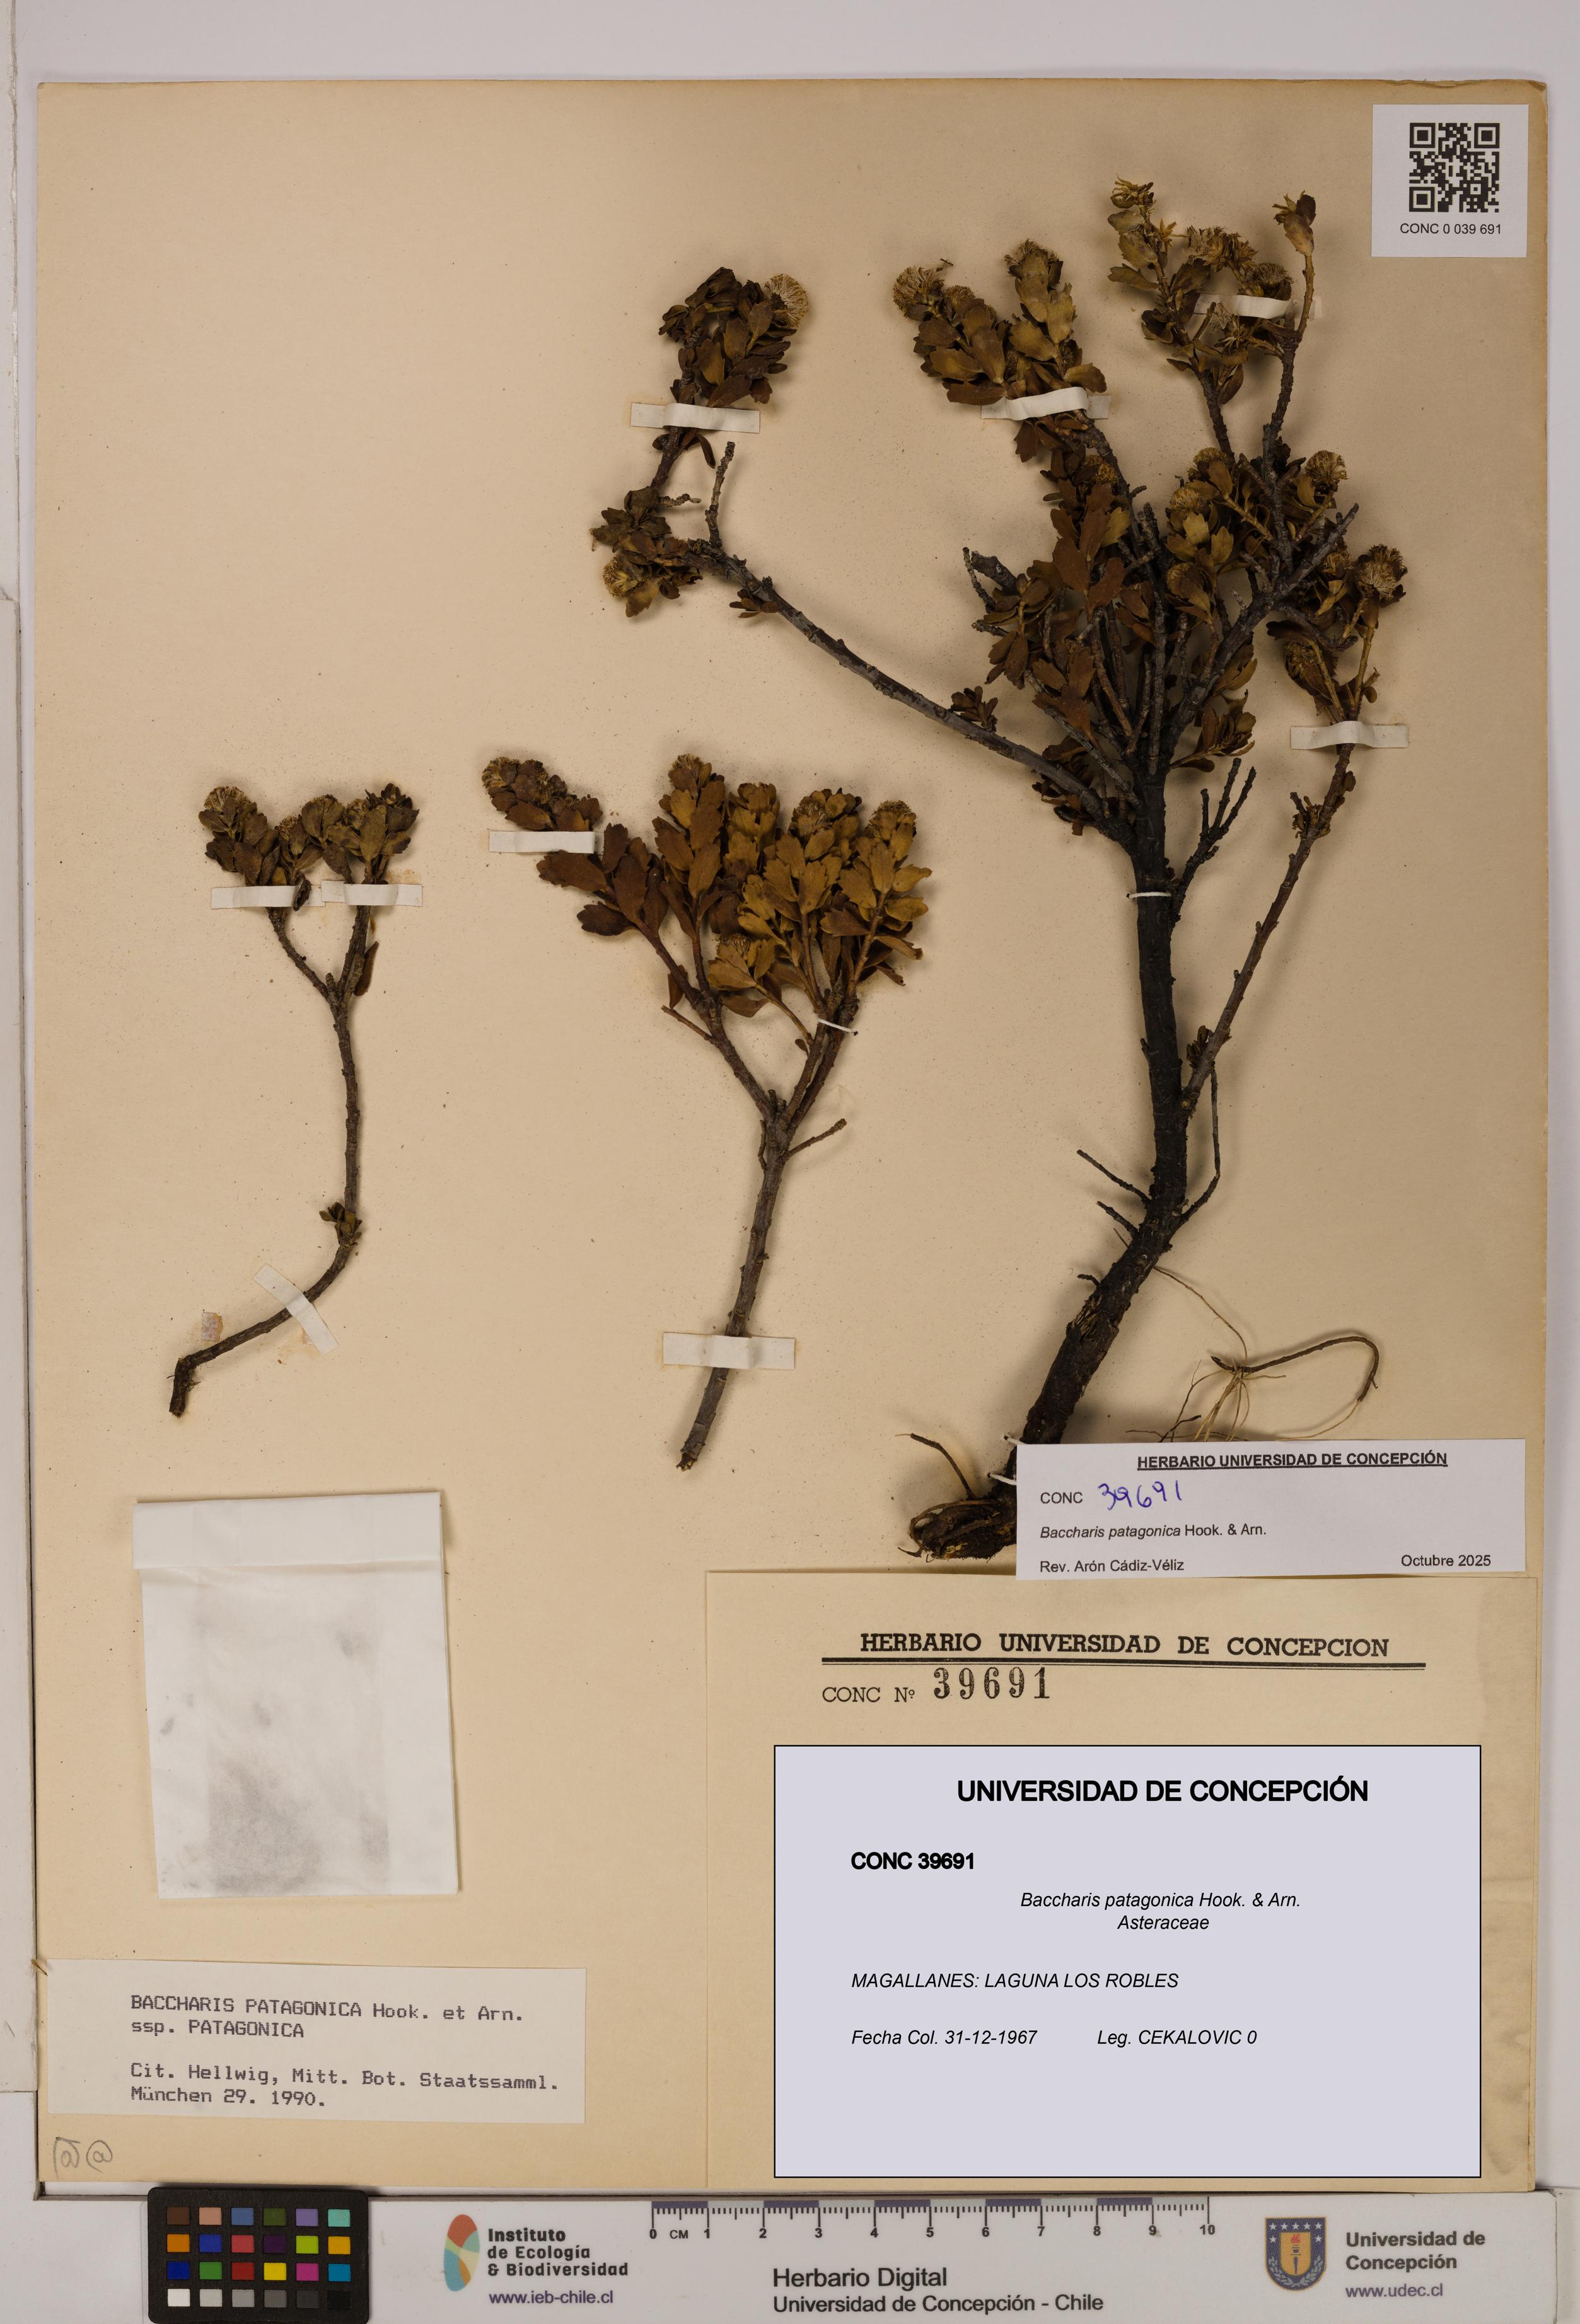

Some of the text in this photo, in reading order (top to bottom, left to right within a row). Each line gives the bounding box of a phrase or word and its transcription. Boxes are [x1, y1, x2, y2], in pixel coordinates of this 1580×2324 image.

[1400, 223, 1501, 234] CONC 0 039 691
[1137, 1450, 1448, 1469] HERBARIO UNIVERSIDAD DE CONCEPCIÓN
[1040, 1491, 1083, 1505] CONC
[1098, 1480, 1182, 1511] 39691
[1040, 1523, 1266, 1541] Baccharis patagonica Hook. & Arn.
[1040, 1558, 1185, 1573] Rev. Arón Cádiz-Véliz
[1401, 1554, 1491, 1567] Octubre 2025
[860, 1633, 1390, 1657] HERBARIO UNIVERSIDAD DE CONCEPCION
[822, 1686, 881, 1703] CONC
[933, 1667, 1050, 1700] 39691
[131, 1994, 522, 2021] BACCHARIS PATAGONICA Hook. et Arn.
[131, 2019, 304, 2038] ssp. PATAGONICA
[131, 2062, 557, 2090] Cit. Hellwig, Mitt. Bot. Staatssamml.
[131, 2086, 325, 2107] München 29. 1990.
[488, 2227, 566, 2242] Instituto
[649, 2225, 1216, 2240] 0 CM 1 2 3 4 5 6 7 8 9 10
[1346, 2230, 1486, 2248] Universidad de
[487, 2245, 590, 2260] de Ecología
[487, 2262, 628, 2277] & Biodiversidad
[1345, 2253, 1457, 2274] Concepción
[773, 2267, 947, 2292] Herbario Digital
[489, 2290, 613, 2304] www.ieb-chile.cl
[1345, 2282, 1443, 2298] www.udec.cl
[774, 2295, 886, 2313] Universidad
[892, 2295, 916, 2312] de
[922, 2294, 1035, 2315] Concepción
[1055, 2294, 1104, 2311] Chile
